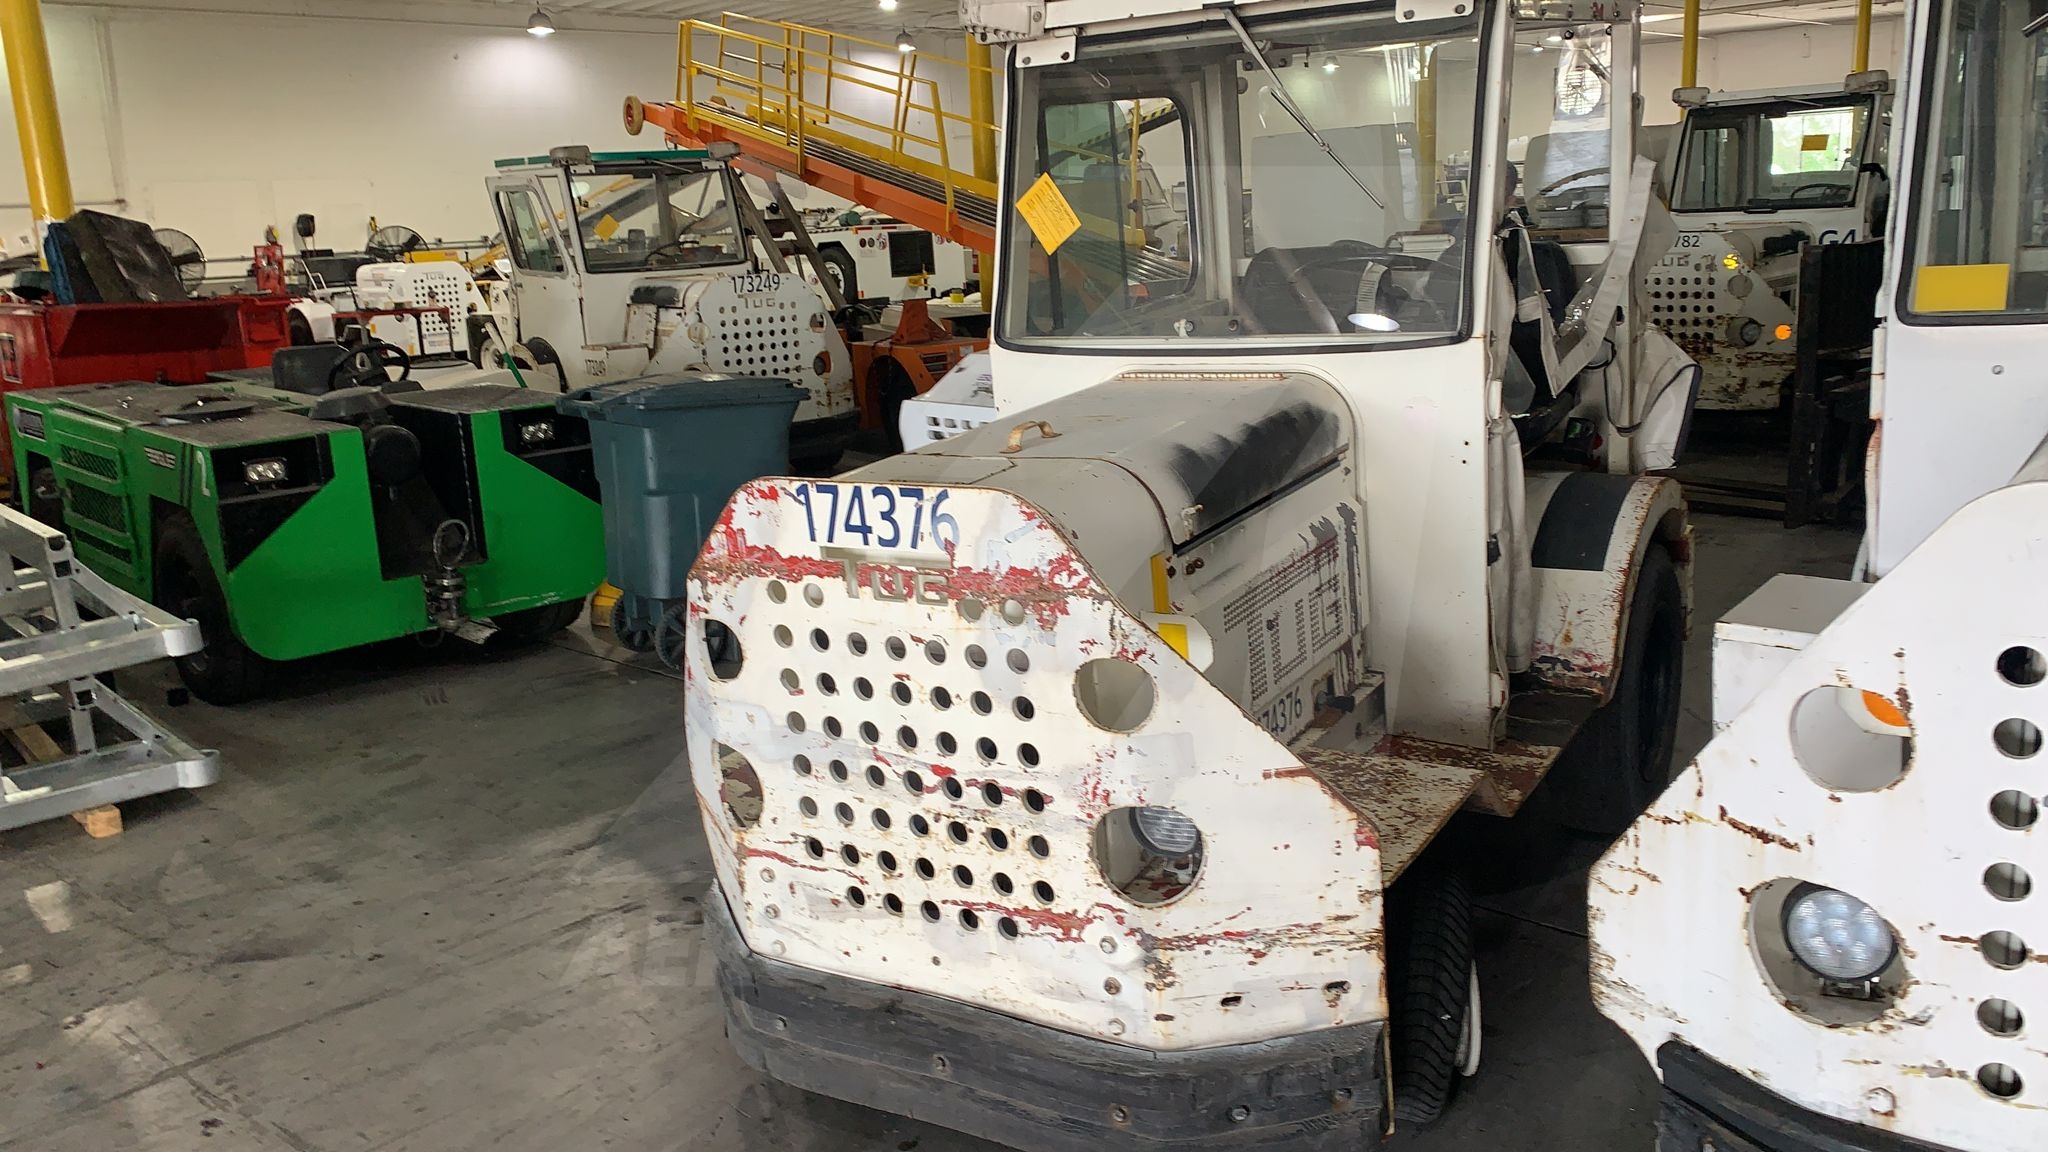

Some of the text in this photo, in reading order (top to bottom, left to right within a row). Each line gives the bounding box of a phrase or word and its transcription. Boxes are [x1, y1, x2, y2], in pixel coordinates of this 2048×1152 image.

[731, 273, 780, 294] 173249
[796, 483, 960, 552] 174376
[1258, 685, 1302, 738] 74376
